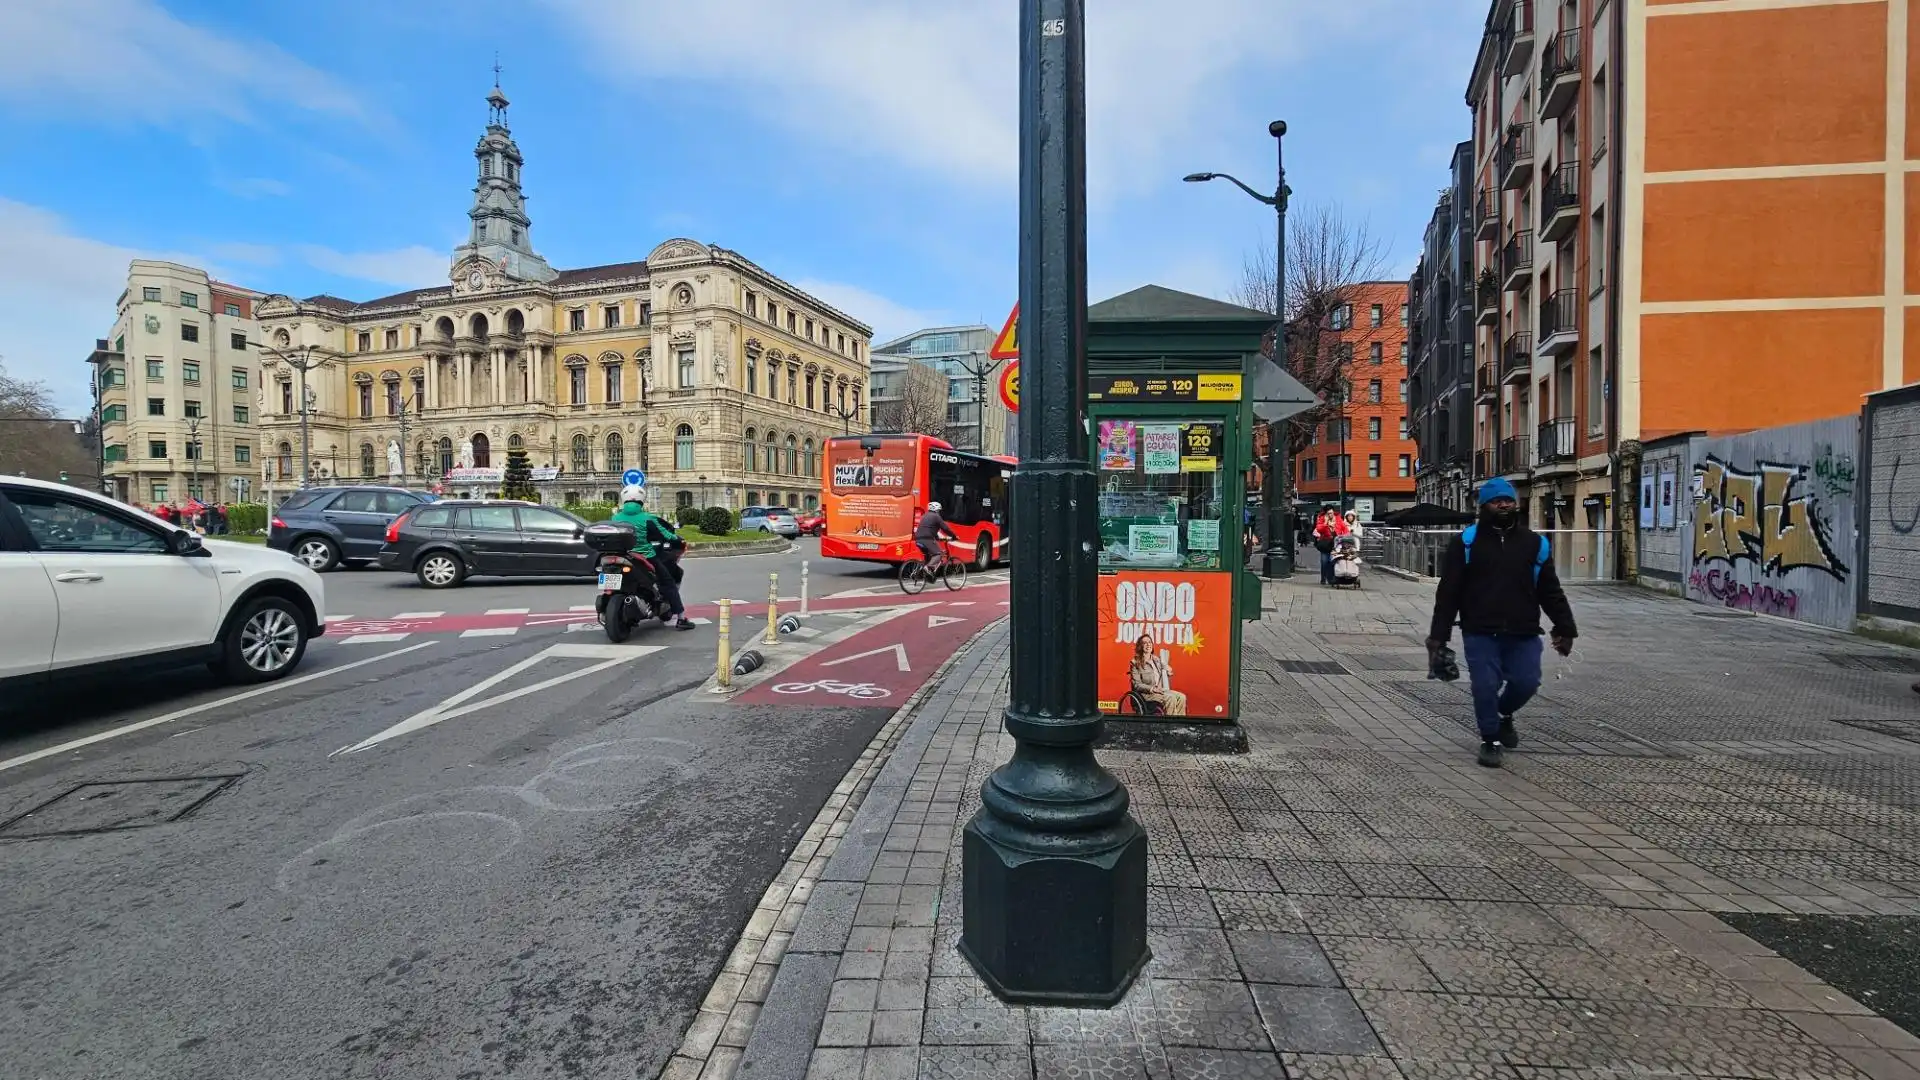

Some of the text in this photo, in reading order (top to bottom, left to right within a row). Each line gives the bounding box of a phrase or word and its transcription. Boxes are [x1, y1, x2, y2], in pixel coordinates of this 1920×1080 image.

[1044, 20, 1063, 34] 45
[1171, 380, 1193, 391] 120
[1187, 435, 1211, 447] 120
[930, 452, 957, 464] CITARO
[835, 466, 856, 475] MUY
[873, 466, 903, 474] MUCHOS
[873, 475, 902, 486] cars
[1116, 581, 1195, 623] ONDO
[1114, 622, 1195, 645] JOKATUTA
